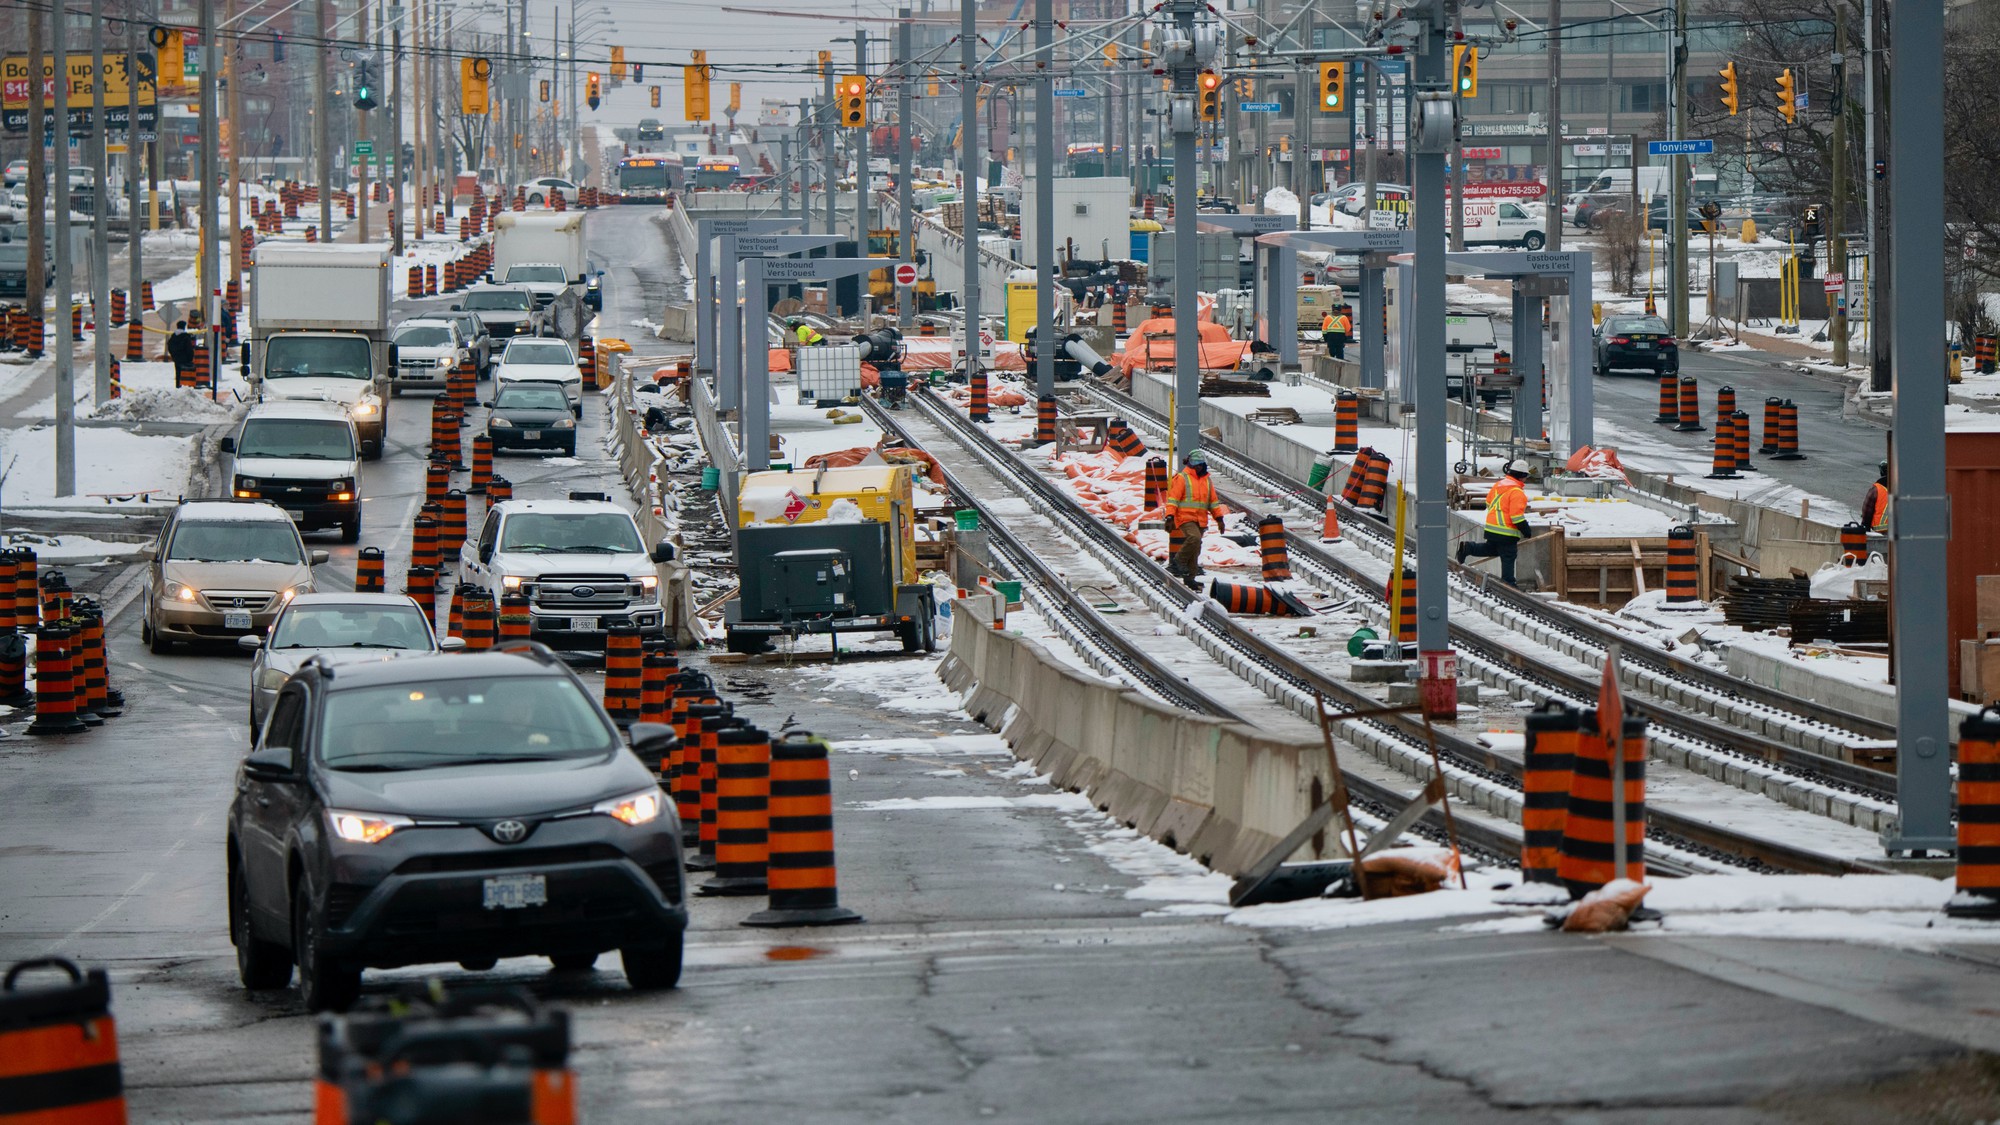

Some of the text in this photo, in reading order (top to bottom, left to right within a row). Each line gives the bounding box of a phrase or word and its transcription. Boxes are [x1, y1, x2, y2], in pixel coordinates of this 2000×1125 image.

[72, 65, 92, 78] up
[73, 80, 113, 95] Fat.
[111, 110, 154, 121] Locaons
[1659, 143, 1696, 152] Ionview
[1493, 186, 1540, 194] 416-755-2553
[1464, 206, 1496, 215] CLINIC
[767, 261, 814, 269] Westbound
[1551, 262, 1570, 270] l'est
[787, 269, 816, 277] l'ouest
